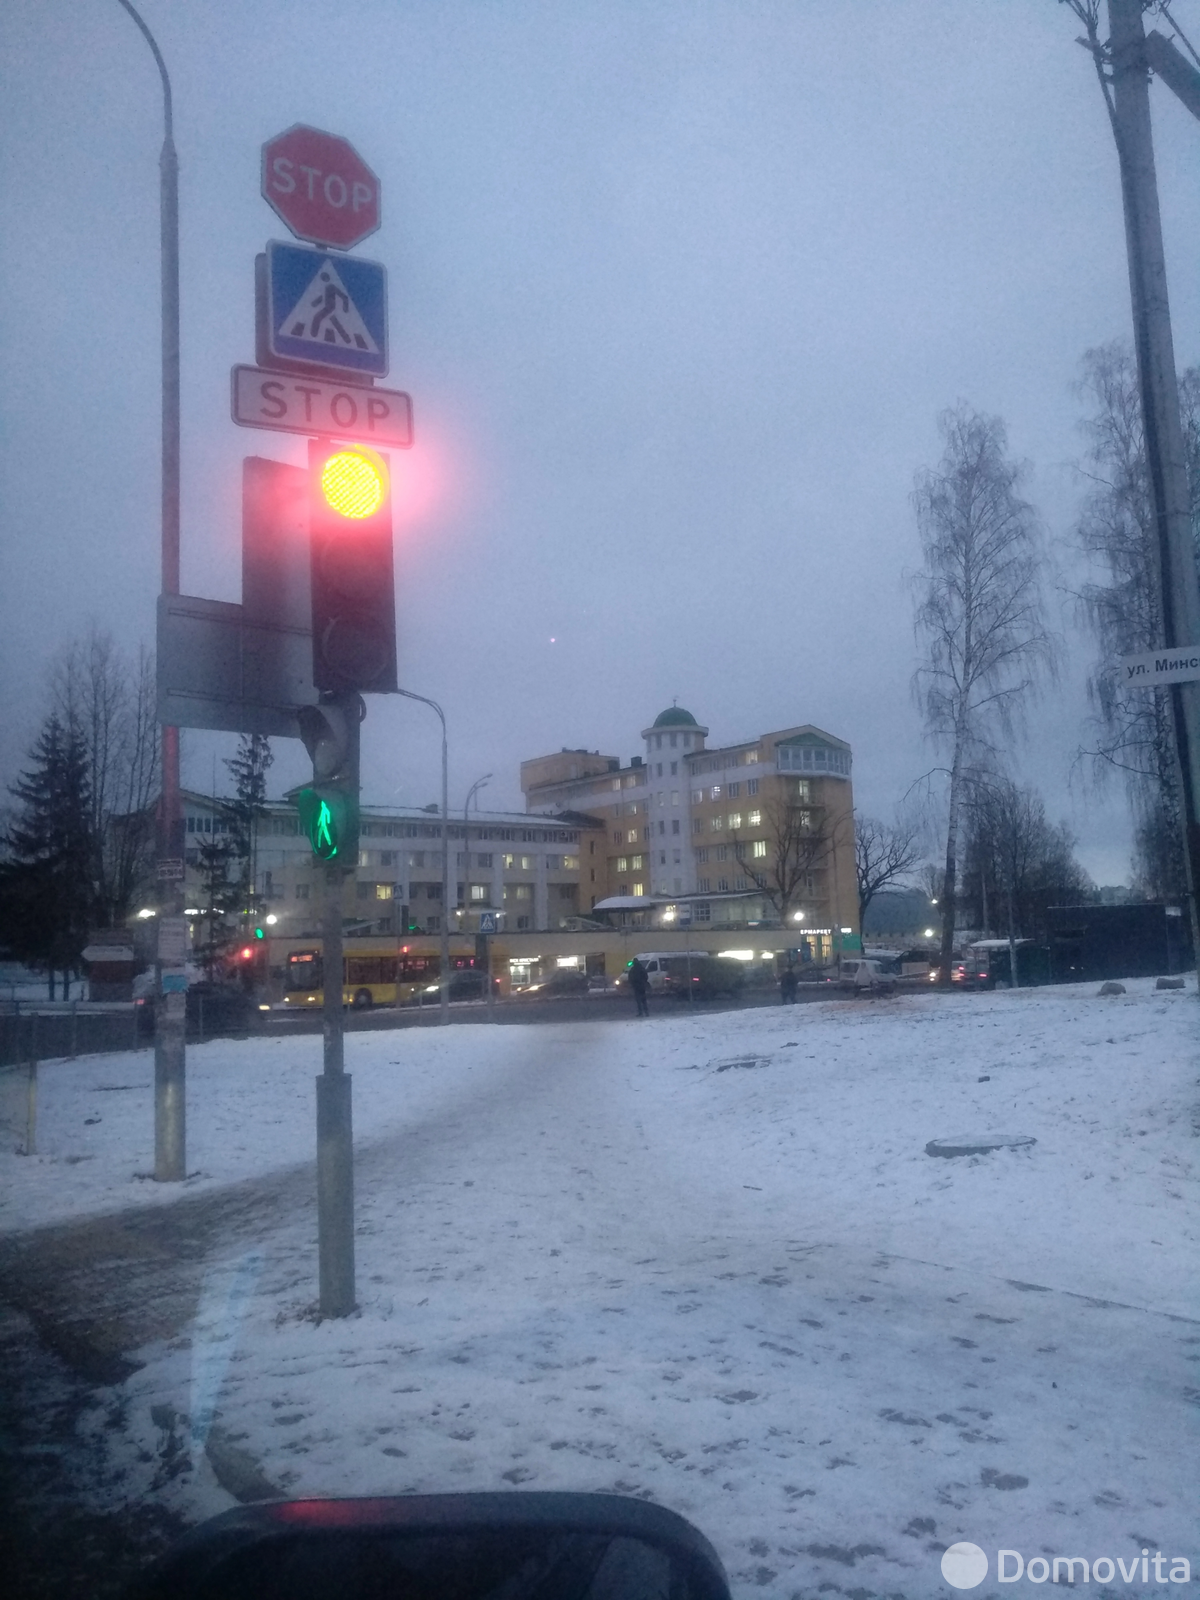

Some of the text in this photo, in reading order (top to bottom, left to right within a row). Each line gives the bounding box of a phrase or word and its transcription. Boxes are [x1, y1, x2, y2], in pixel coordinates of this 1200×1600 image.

[271, 157, 372, 212] STOP
[260, 380, 390, 432] STOP
[1127, 658, 1200, 679] ул. Минс
